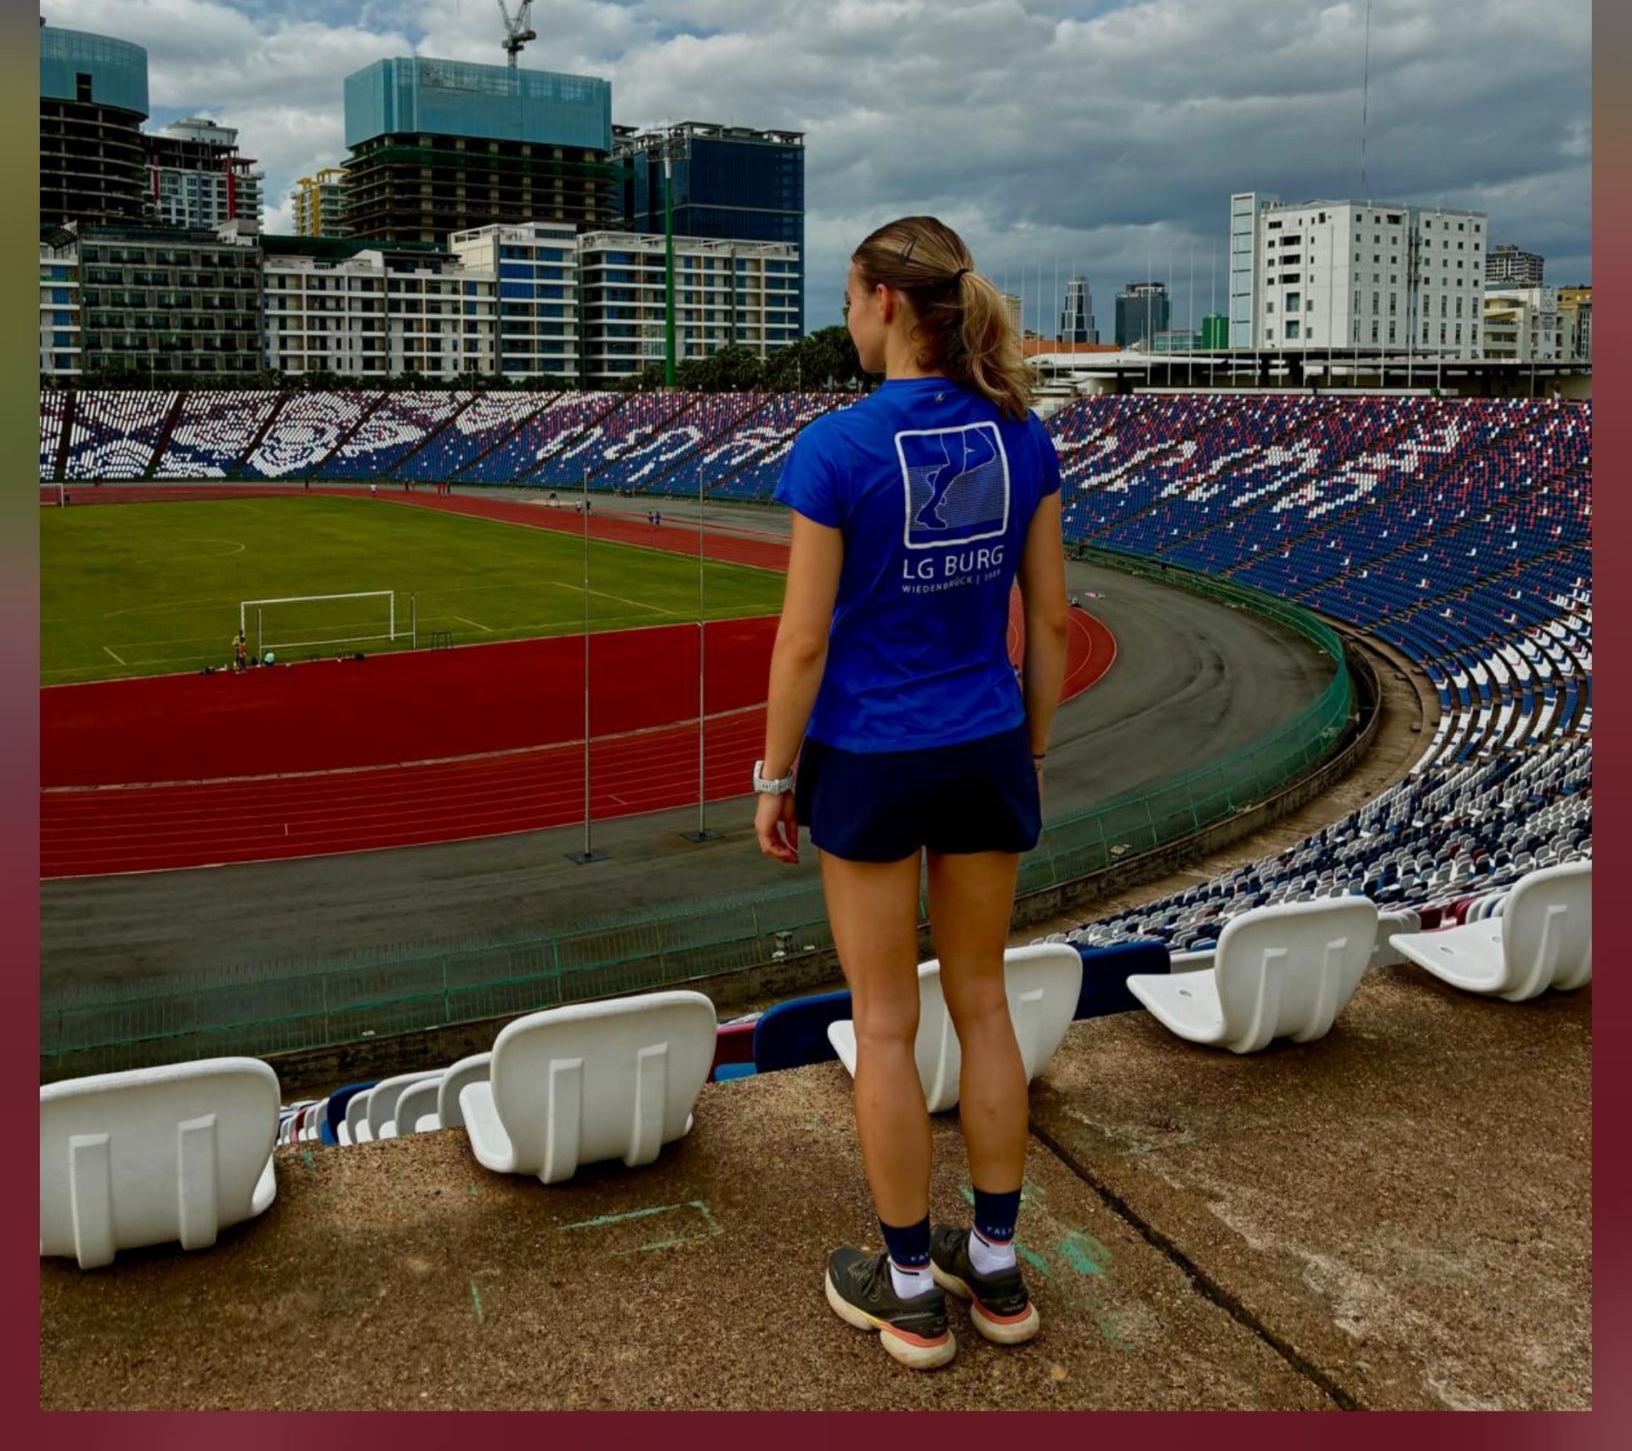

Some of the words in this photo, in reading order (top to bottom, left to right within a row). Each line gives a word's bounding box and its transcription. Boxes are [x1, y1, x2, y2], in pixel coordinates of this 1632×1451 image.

[903, 558, 935, 579] LG
[944, 545, 1004, 576] BURG
[901, 575, 972, 593] WIEDENBRÜCK
